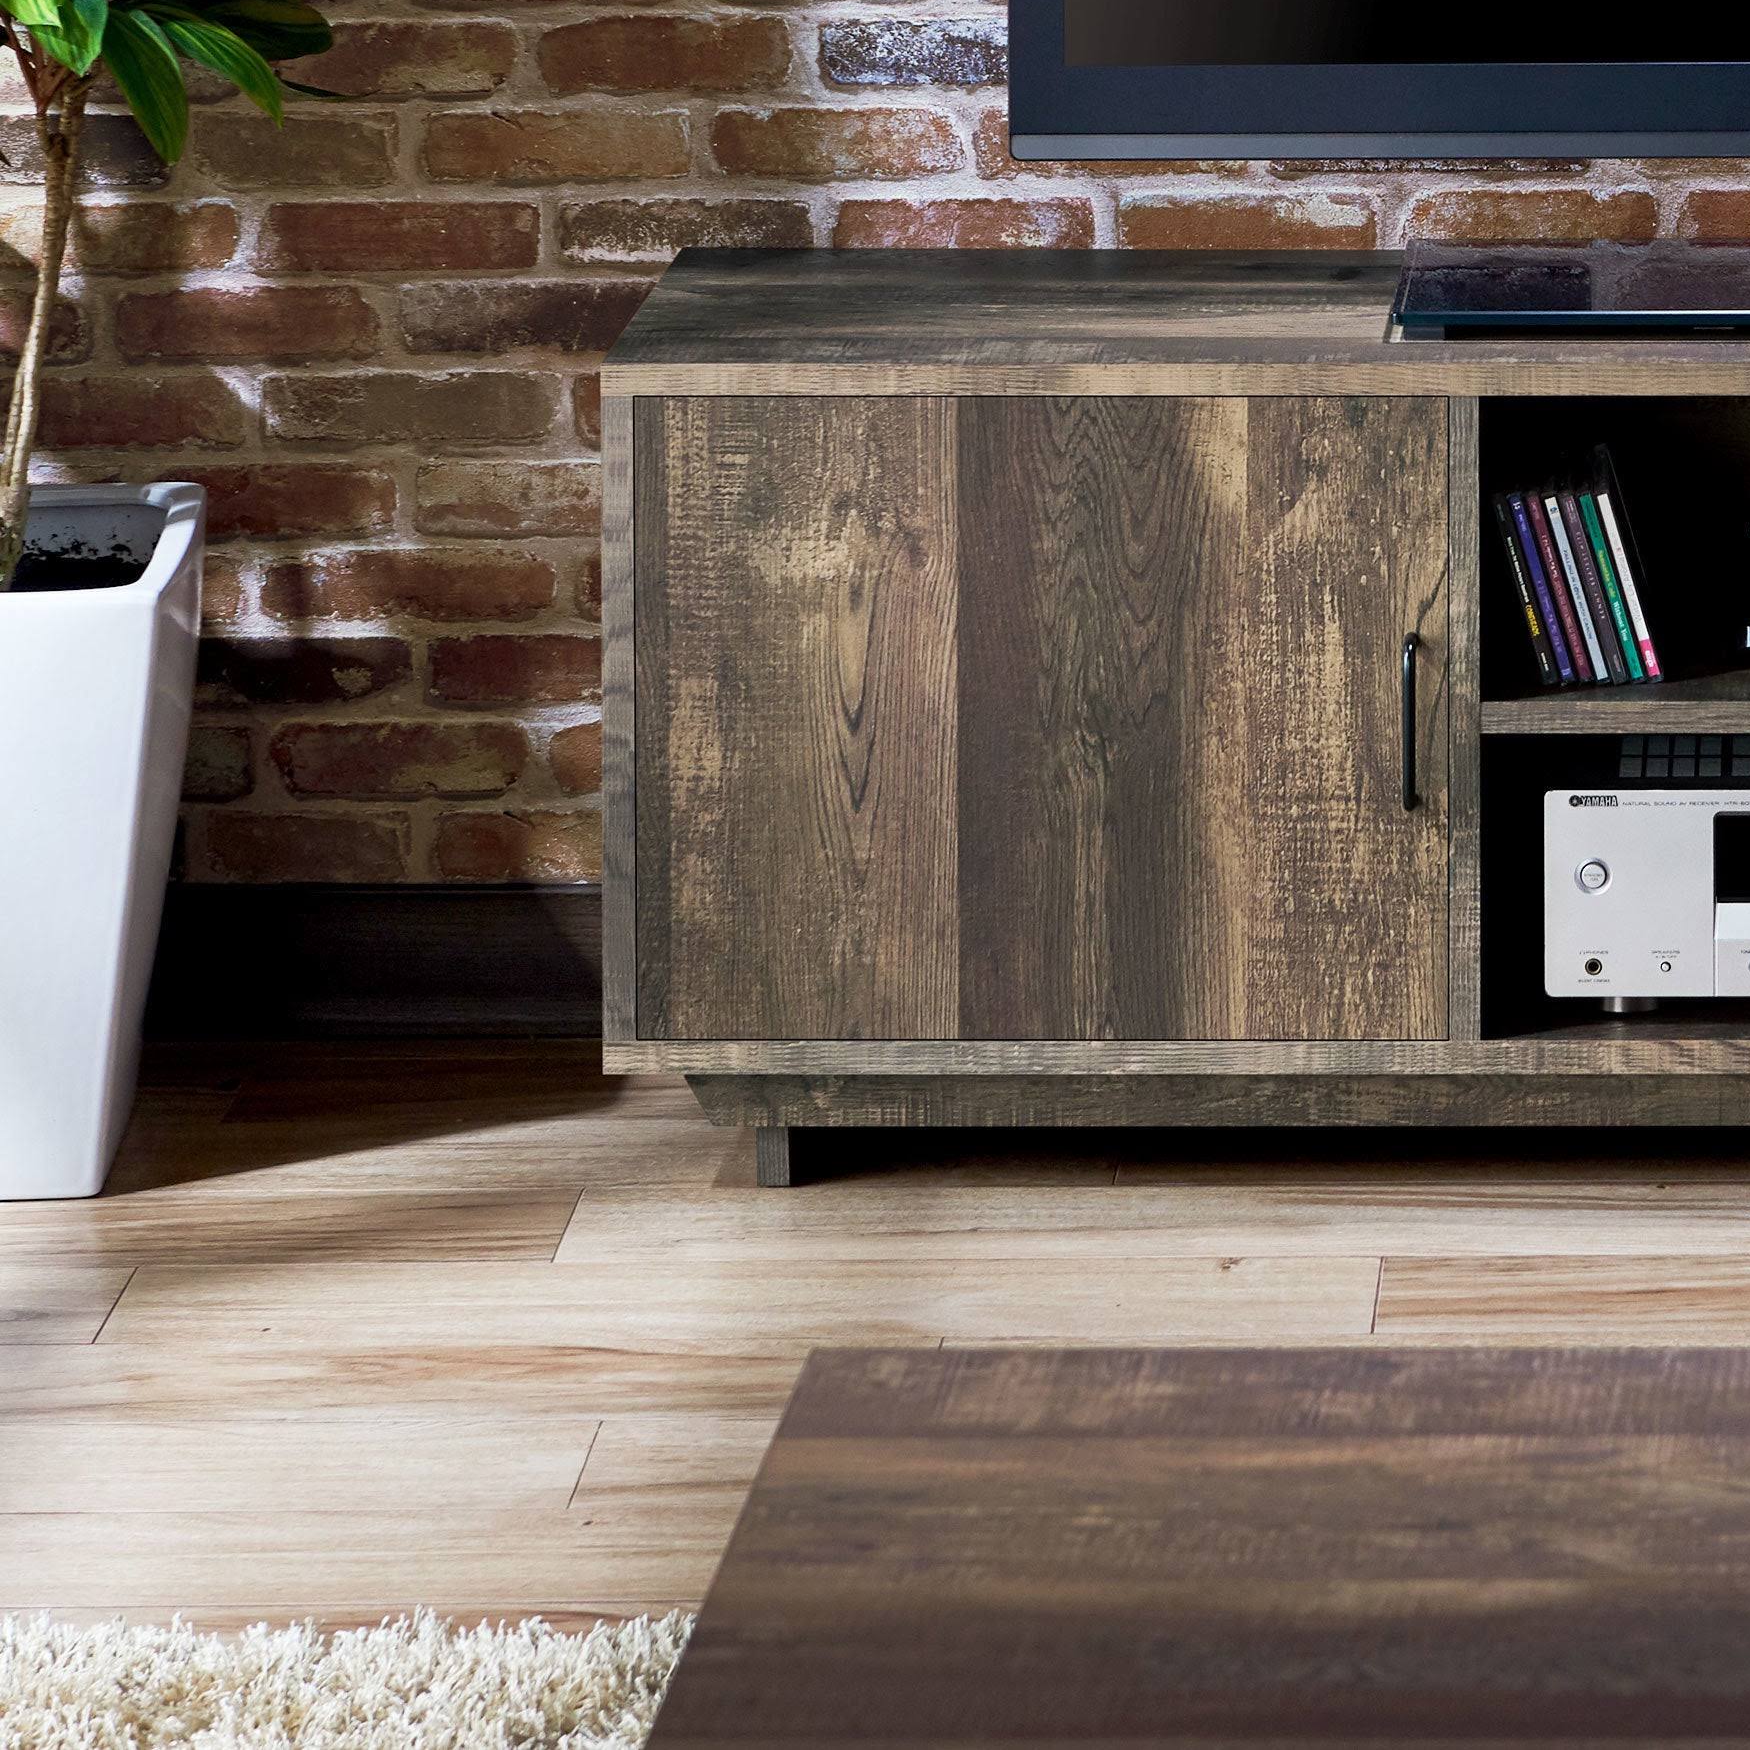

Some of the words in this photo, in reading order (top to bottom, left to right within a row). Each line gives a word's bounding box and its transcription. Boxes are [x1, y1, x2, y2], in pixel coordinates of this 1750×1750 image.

[1614, 601, 1624, 627] Without
[1621, 628, 1629, 641] You
[1581, 795, 1618, 806] YAMAHA
